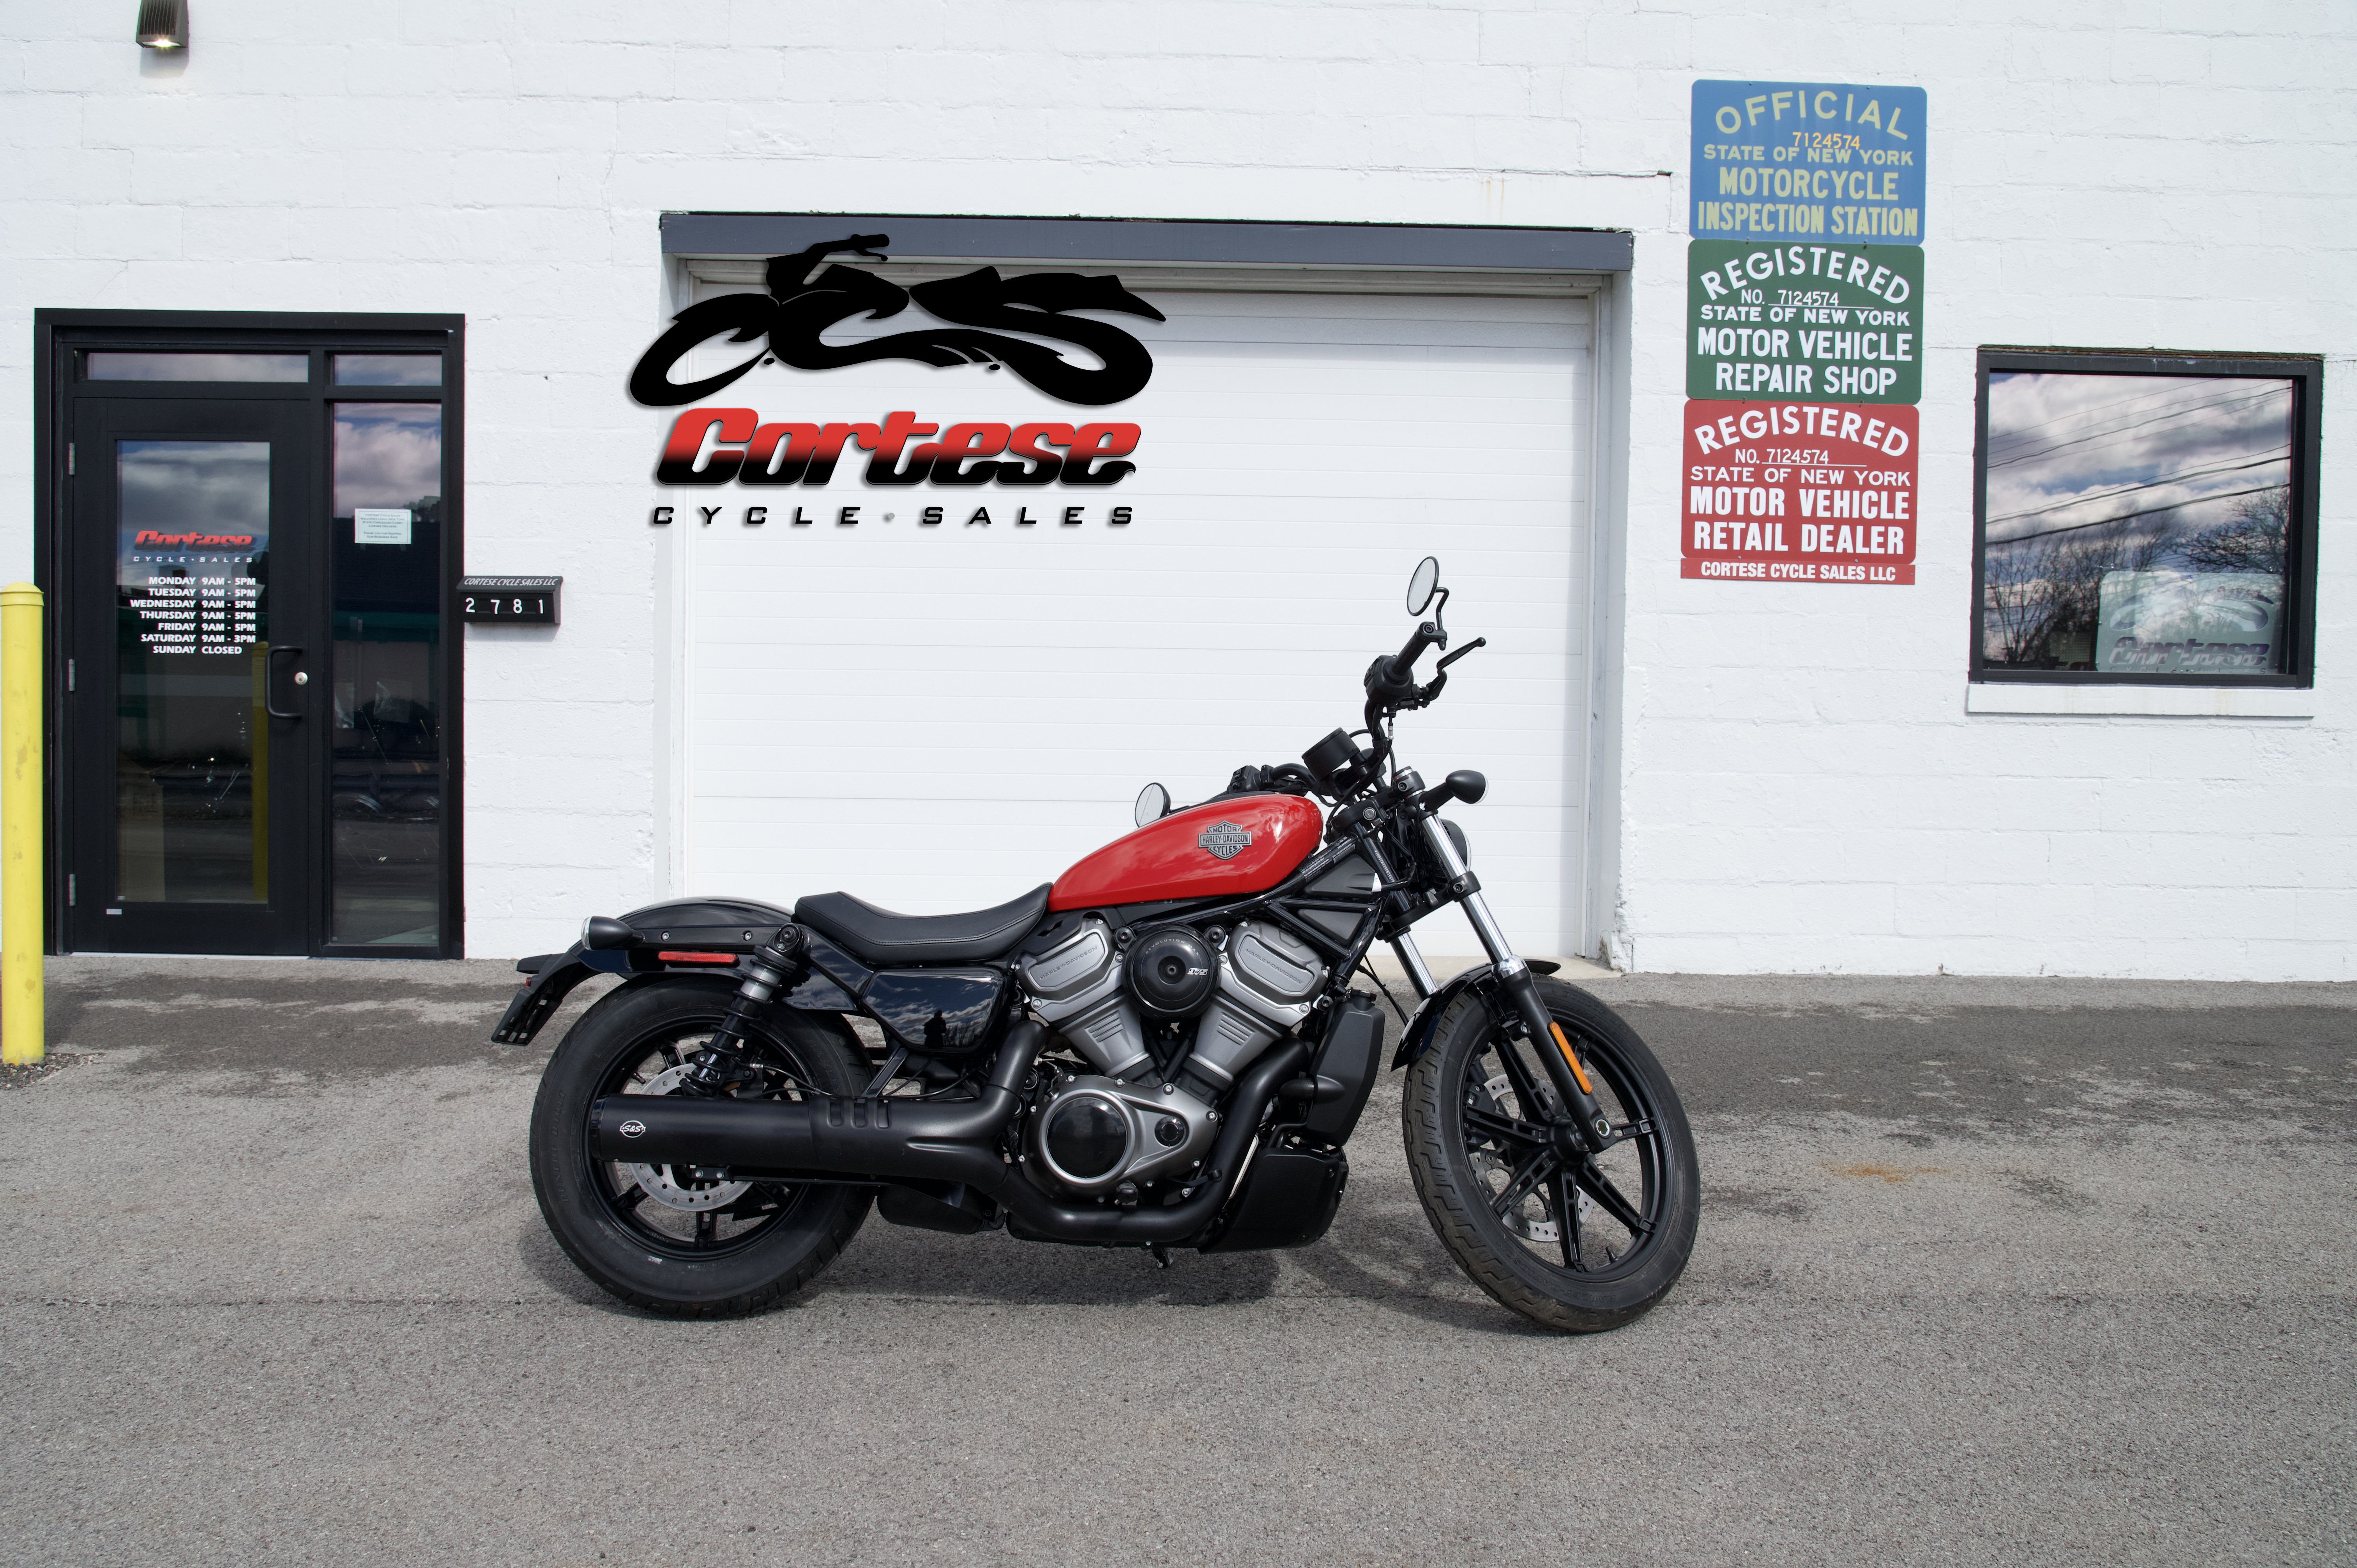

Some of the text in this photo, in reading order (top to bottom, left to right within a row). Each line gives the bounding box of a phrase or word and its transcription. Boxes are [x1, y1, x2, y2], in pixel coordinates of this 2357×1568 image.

[1716, 90, 1908, 140] OFFICIAL
[1792, 132, 1861, 150] 7124574
[1703, 144, 1914, 166] STATE OF NEW YORK
[1719, 167, 1899, 201] MOTORCYCLE
[1698, 201, 1918, 237] INSPECTION STATION
[1700, 245, 1910, 304] REGISTERED
[1740, 289, 1839, 307] NO. 7124574
[1700, 304, 1910, 327] STATE OF NEW YORK
[1697, 327, 1913, 361] MOTOR VEHICLE
[1716, 362, 1897, 396] REPAIR SHOP
[1694, 405, 1909, 457] REGISTERED
[1735, 448, 1829, 464] NO. 7124574
[1690, 466, 1911, 487] STATE OF NEW YORK
[1690, 486, 1910, 520] MOTOR VEHICLE
[134, 530, 253, 552] Cortese
[1694, 521, 1904, 554] RETAIL DEALER
[148, 577, 196, 585] MONDAY
[1701, 561, 1896, 581] CORTESE CYCLE SALES LLC
[148, 588, 196, 596] TUESDAY
[201, 589, 225, 597] 9AM
[234, 589, 256, 597] 5PM
[130, 599, 196, 608] WEDNESDAY
[201, 600, 225, 609] 9AM
[234, 600, 256, 609] 5PM
[465, 597, 544, 614] 2781
[140, 611, 196, 620] THURSDAY
[201, 612, 225, 620] 9AM
[234, 612, 256, 620] 5PM
[157, 622, 196, 631] FRIDAY
[201, 623, 225, 632] 9AM
[234, 623, 256, 632] 5PM
[140, 634, 196, 643] SATURDAY
[201, 634, 225, 643] 9AM
[234, 634, 256, 643] 3PM
[152, 645, 243, 655] SUNDAY CLOSED
[1213, 824, 1237, 833] MOTOR
[1202, 834, 1248, 844] HARLEY-DAVIDSON
[1213, 845, 1237, 856] CYCLES
[1145, 938, 1200, 956] REVOLUTION MAX
[1039, 945, 1098, 984] HARLEY-DAVIDSON
[1245, 948, 1303, 985] HARLEY-DAVIDSON
